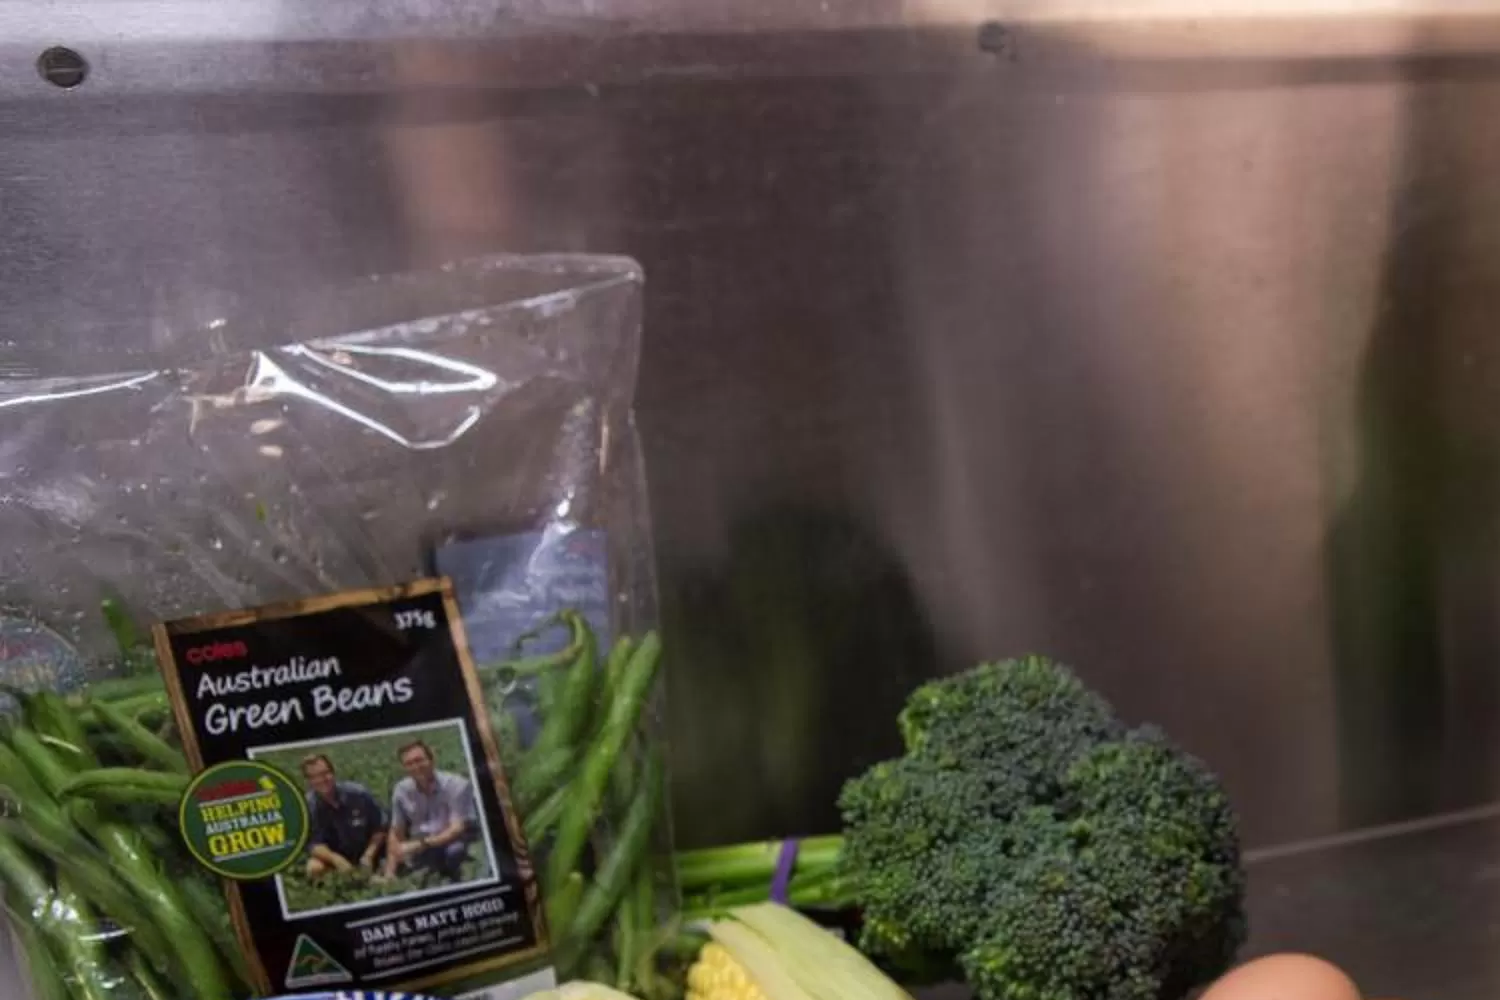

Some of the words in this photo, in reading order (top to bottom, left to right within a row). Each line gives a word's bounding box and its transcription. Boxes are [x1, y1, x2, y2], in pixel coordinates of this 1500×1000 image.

[394, 609, 436, 630] 375g
[196, 656, 342, 699] Australian
[204, 697, 304, 735] Green
[311, 676, 414, 718] Beans
[200, 791, 281, 822] HELPING
[208, 823, 285, 857] GROW
[361, 922, 396, 944] DAN
[414, 908, 459, 930] MATT
